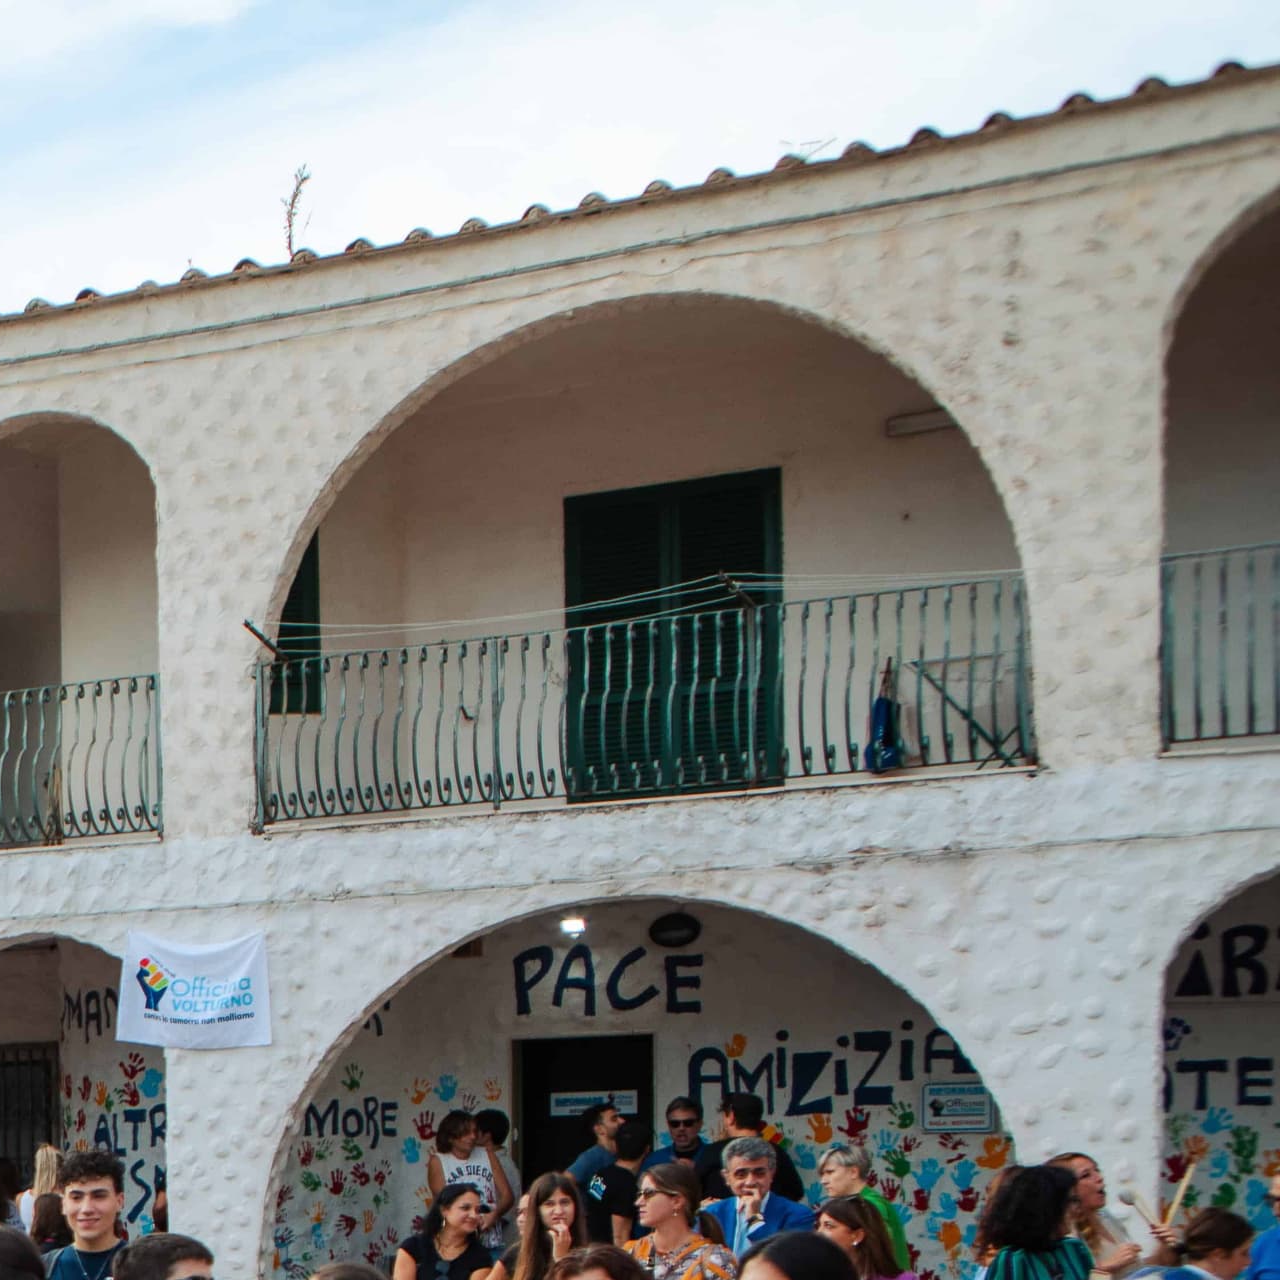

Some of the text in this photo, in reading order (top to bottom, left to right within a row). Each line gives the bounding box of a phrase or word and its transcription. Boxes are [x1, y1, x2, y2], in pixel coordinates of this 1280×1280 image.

[170, 975, 252, 998] Officina
[512, 943, 704, 1016] PACE
[172, 992, 254, 1013] VOLTURNO
[217, 1011, 255, 1023] molliamo
[303, 1096, 399, 1150] MORE
